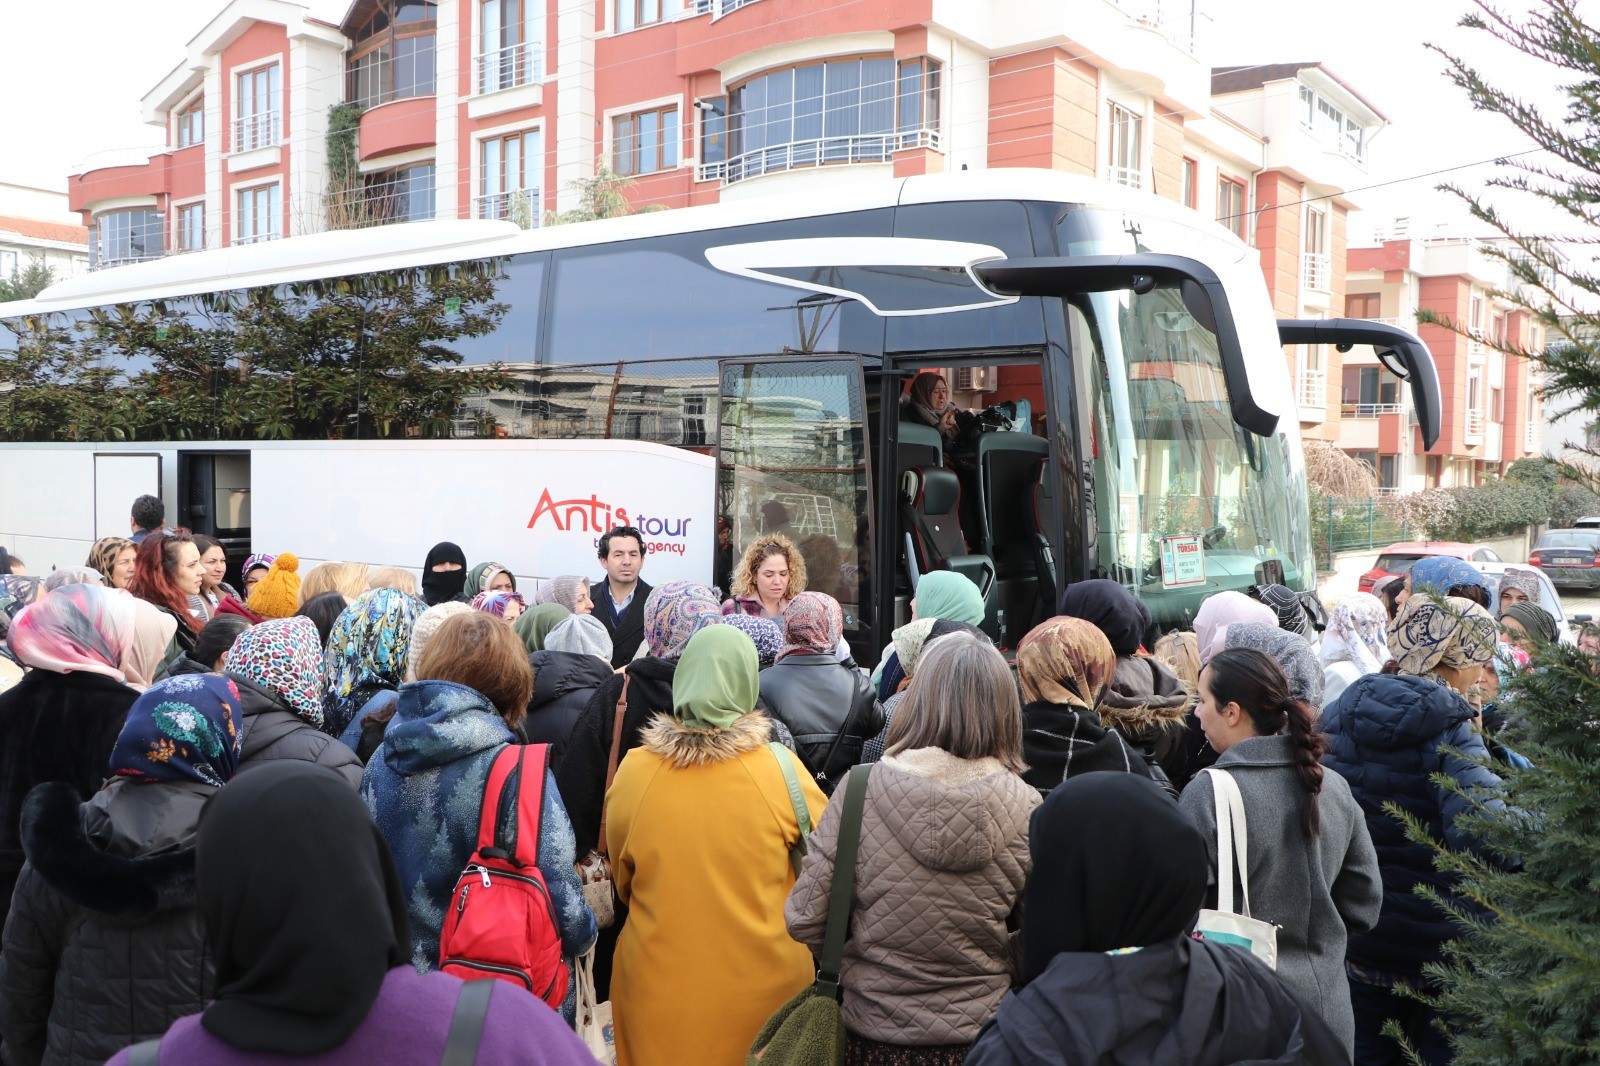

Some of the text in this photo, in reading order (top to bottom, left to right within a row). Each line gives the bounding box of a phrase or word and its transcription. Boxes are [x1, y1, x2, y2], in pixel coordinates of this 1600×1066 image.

[527, 487, 692, 537] Antis tour
[645, 541, 686, 556] gency
